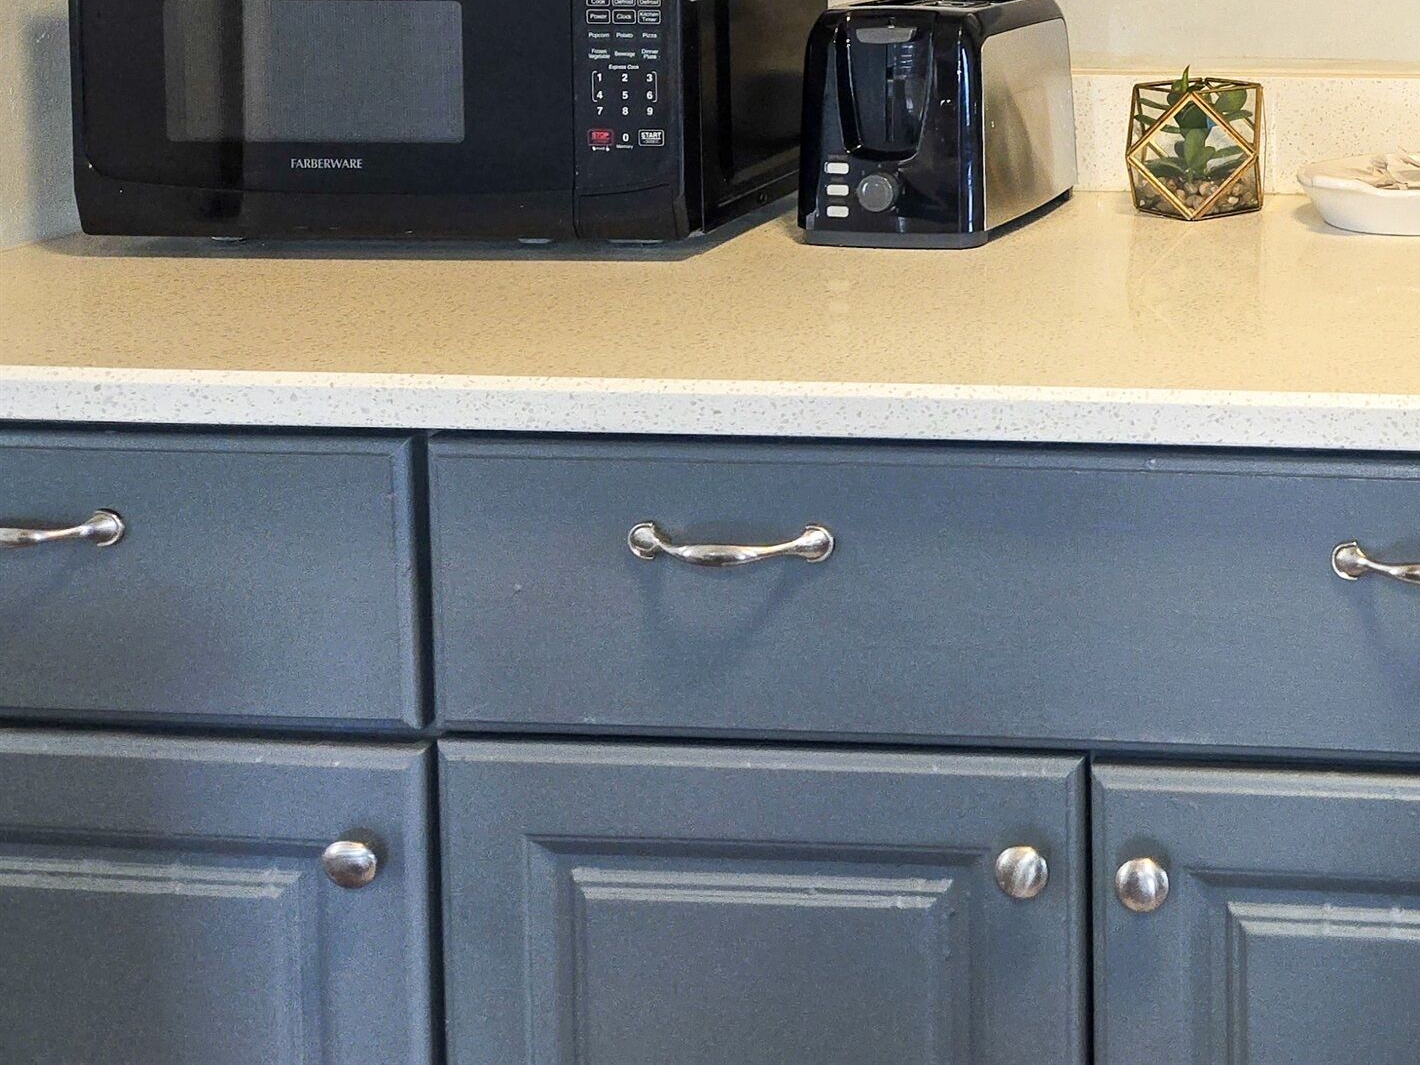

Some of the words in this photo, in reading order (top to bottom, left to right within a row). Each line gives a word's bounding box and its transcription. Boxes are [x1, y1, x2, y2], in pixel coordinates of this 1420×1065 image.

[597, 73, 602, 82] 1
[621, 73, 629, 82] 2
[646, 73, 653, 82] 3
[596, 90, 604, 100] 4
[622, 90, 629, 100] 5
[646, 90, 653, 100] 6
[596, 106, 604, 115] 7
[622, 106, 629, 115] 8
[646, 106, 654, 116] 9
[622, 133, 630, 142] 0
[640, 131, 662, 139] START
[290, 158, 363, 169] FARBERWARE
